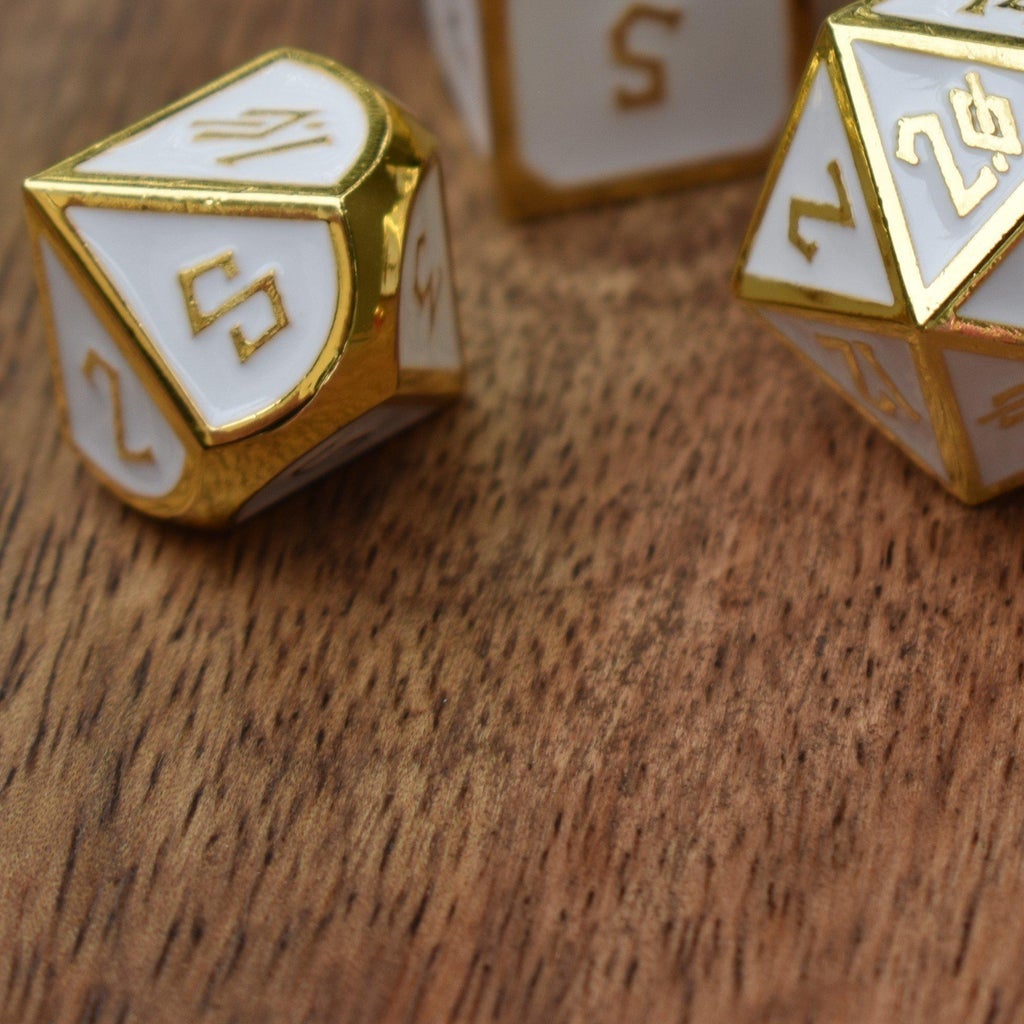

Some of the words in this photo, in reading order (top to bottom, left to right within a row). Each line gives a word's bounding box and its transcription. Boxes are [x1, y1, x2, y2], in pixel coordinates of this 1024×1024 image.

[894, 70, 1024, 218] 20
[787, 159, 857, 264] 2
[81, 347, 158, 468] 2
